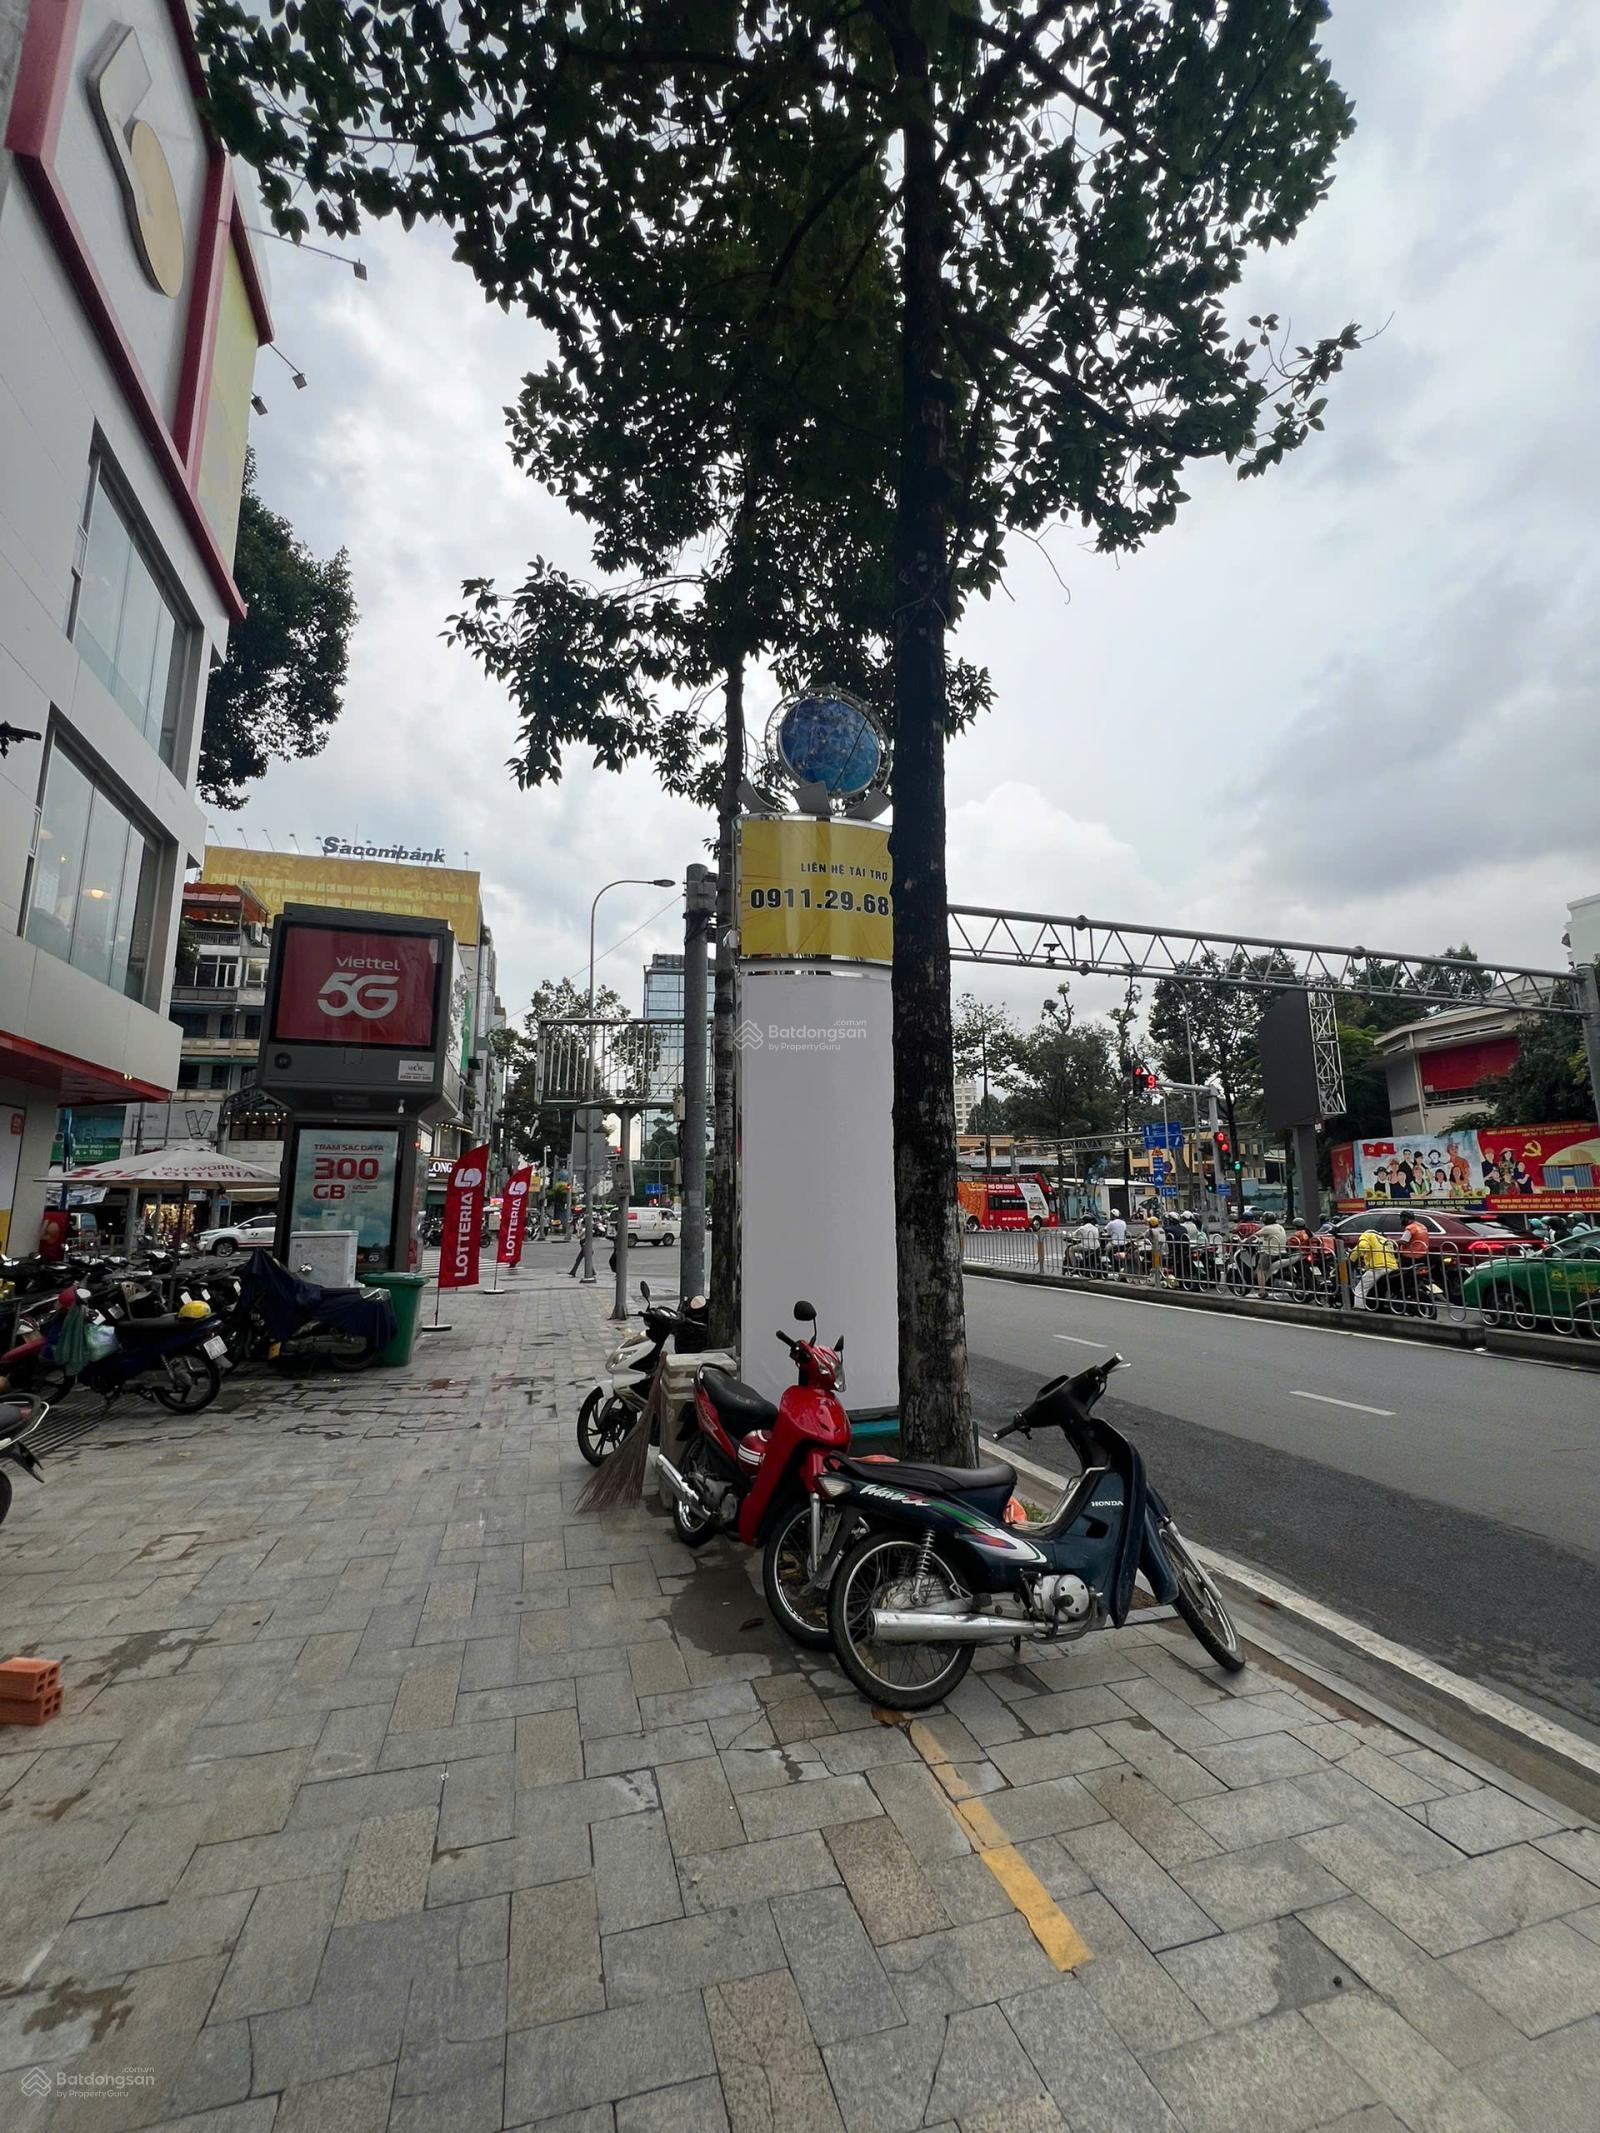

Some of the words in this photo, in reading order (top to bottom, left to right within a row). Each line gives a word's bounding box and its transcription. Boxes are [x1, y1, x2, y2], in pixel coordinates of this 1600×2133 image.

[322, 836, 445, 862] Sacombank
[801, 862, 826, 873] LIÊN
[750, 888, 889, 915] 0911.29.68
[336, 956, 400, 971] viettel
[317, 972, 399, 1019] 5G
[314, 1157, 379, 1180] 300
[313, 1184, 346, 1200] GB
[454, 1191, 474, 1277] LOTTERIA
[505, 1197, 522, 1257] LOTTERIA
[860, 1484, 911, 1501] Wave
[1090, 1500, 1125, 1508] HONDA
